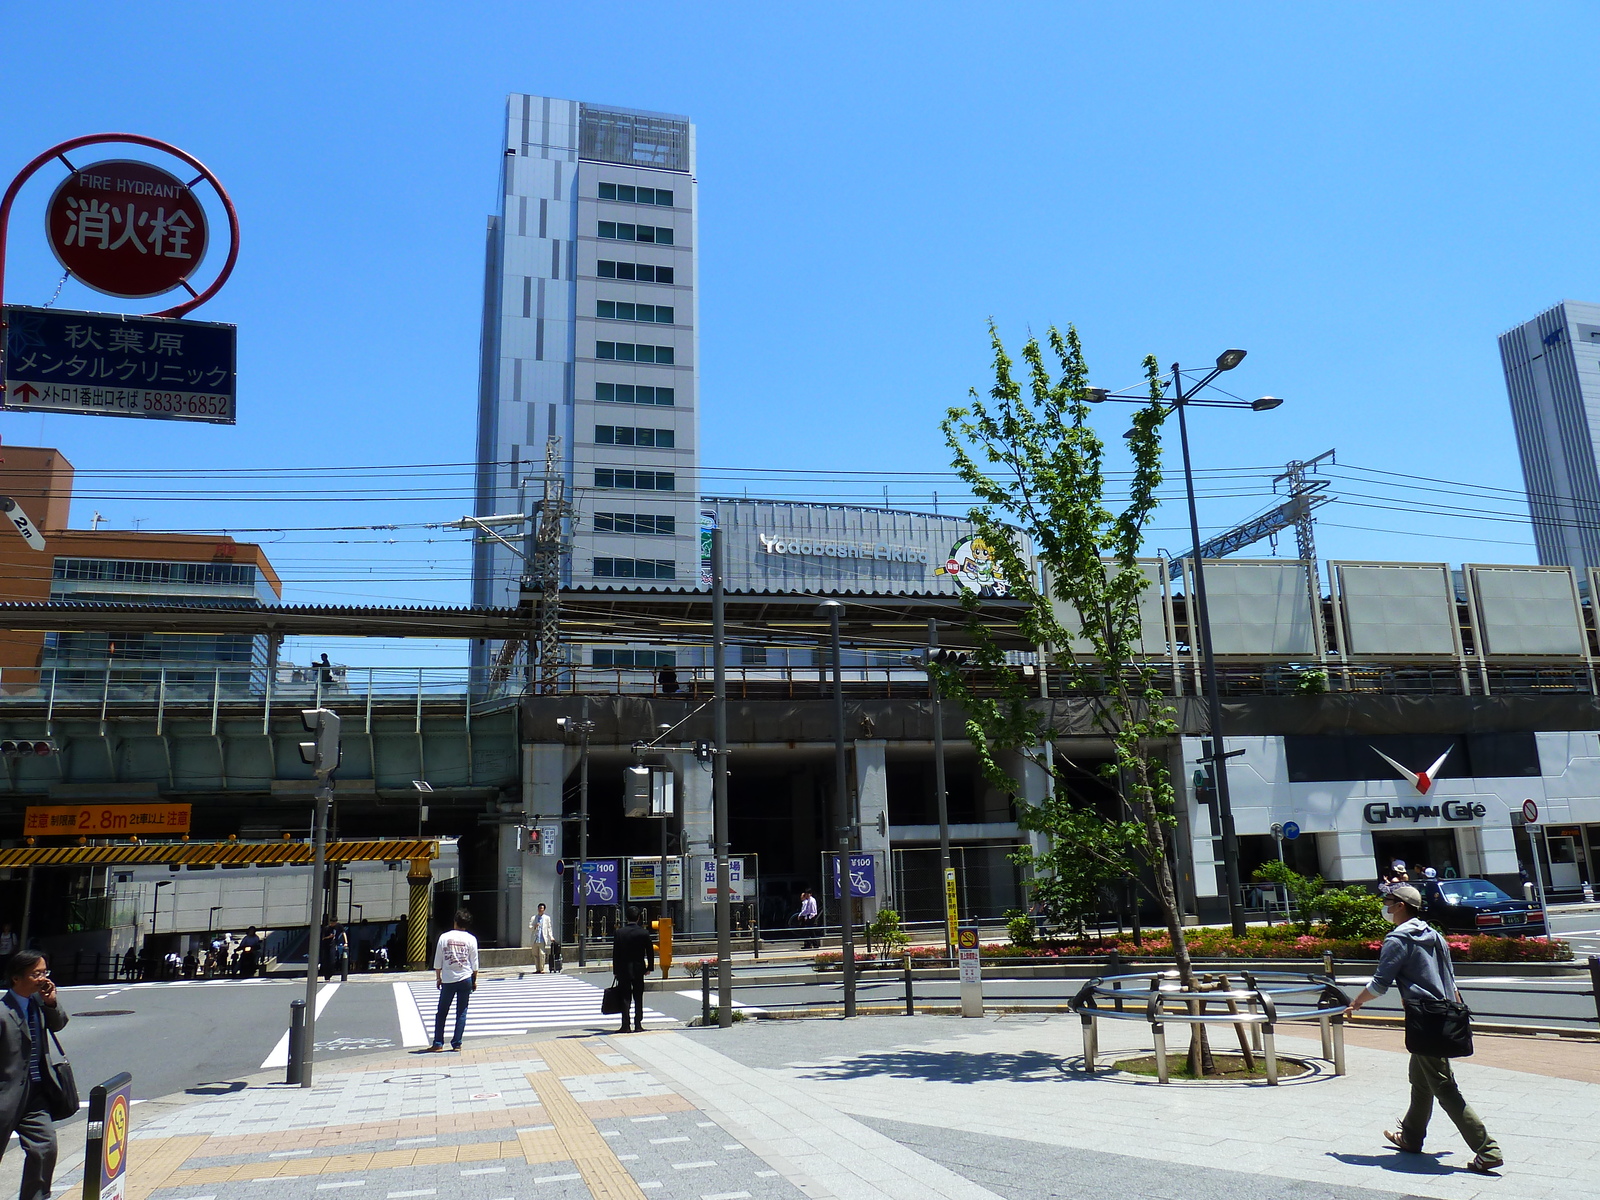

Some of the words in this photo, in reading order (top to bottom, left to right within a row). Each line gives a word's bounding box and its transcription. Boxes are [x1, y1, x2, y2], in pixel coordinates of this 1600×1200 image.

[79, 174, 111, 191] FIRE
[117, 178, 183, 199] HYDRANT
[64, 196, 195, 259] 消火栓
[64, 324, 185, 357] 秋葉原
[16, 351, 228, 387] メンタルクリニック
[41, 386, 138, 408] メトロ1番出口そば
[13, 516, 33, 539] 2m
[27, 813, 49, 829] 注意
[78, 809, 127, 829] 2.8m
[166, 811, 188, 826] 注意
[704, 861, 741, 872] 駐場
